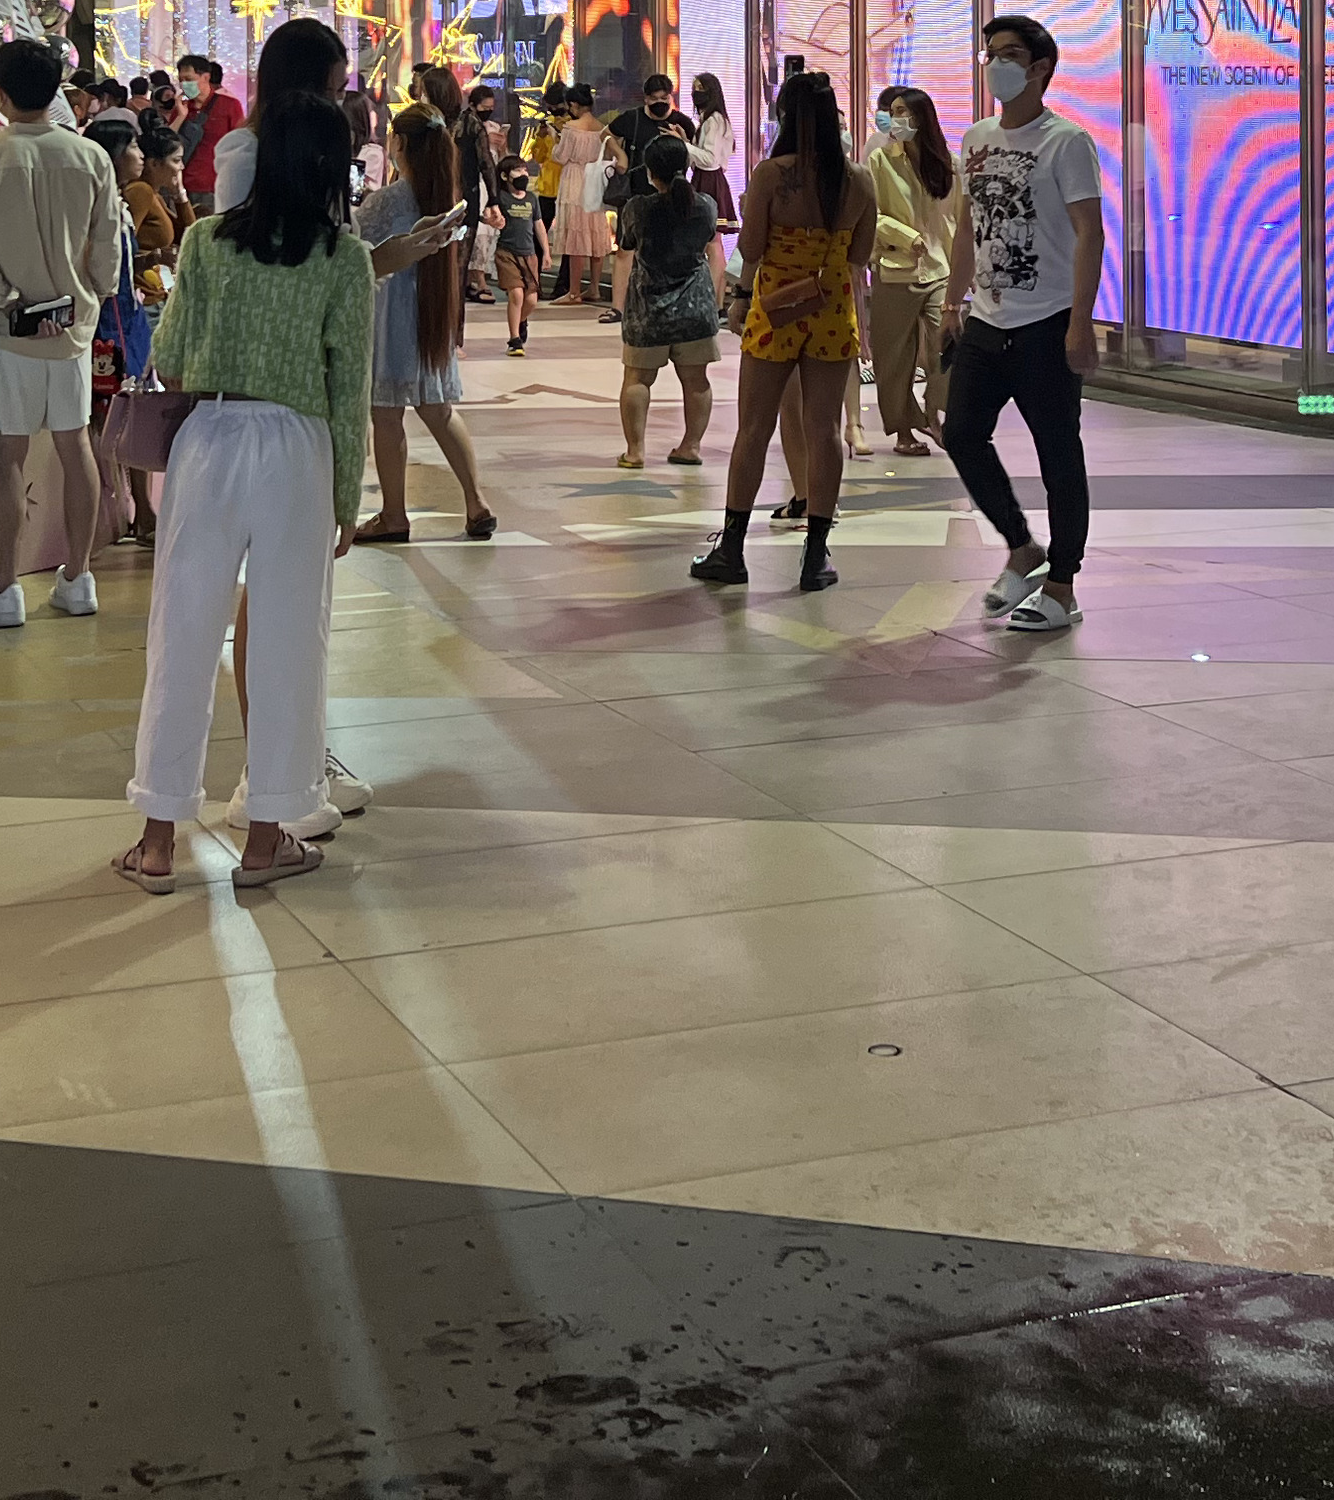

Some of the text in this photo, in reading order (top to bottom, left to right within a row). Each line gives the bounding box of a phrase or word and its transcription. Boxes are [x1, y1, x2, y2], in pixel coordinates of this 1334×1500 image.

[1161, 66, 1187, 85] THE
[1191, 66, 1219, 85] NEW
[1224, 66, 1271, 85] SCENT
[1274, 65, 1295, 85] OF
